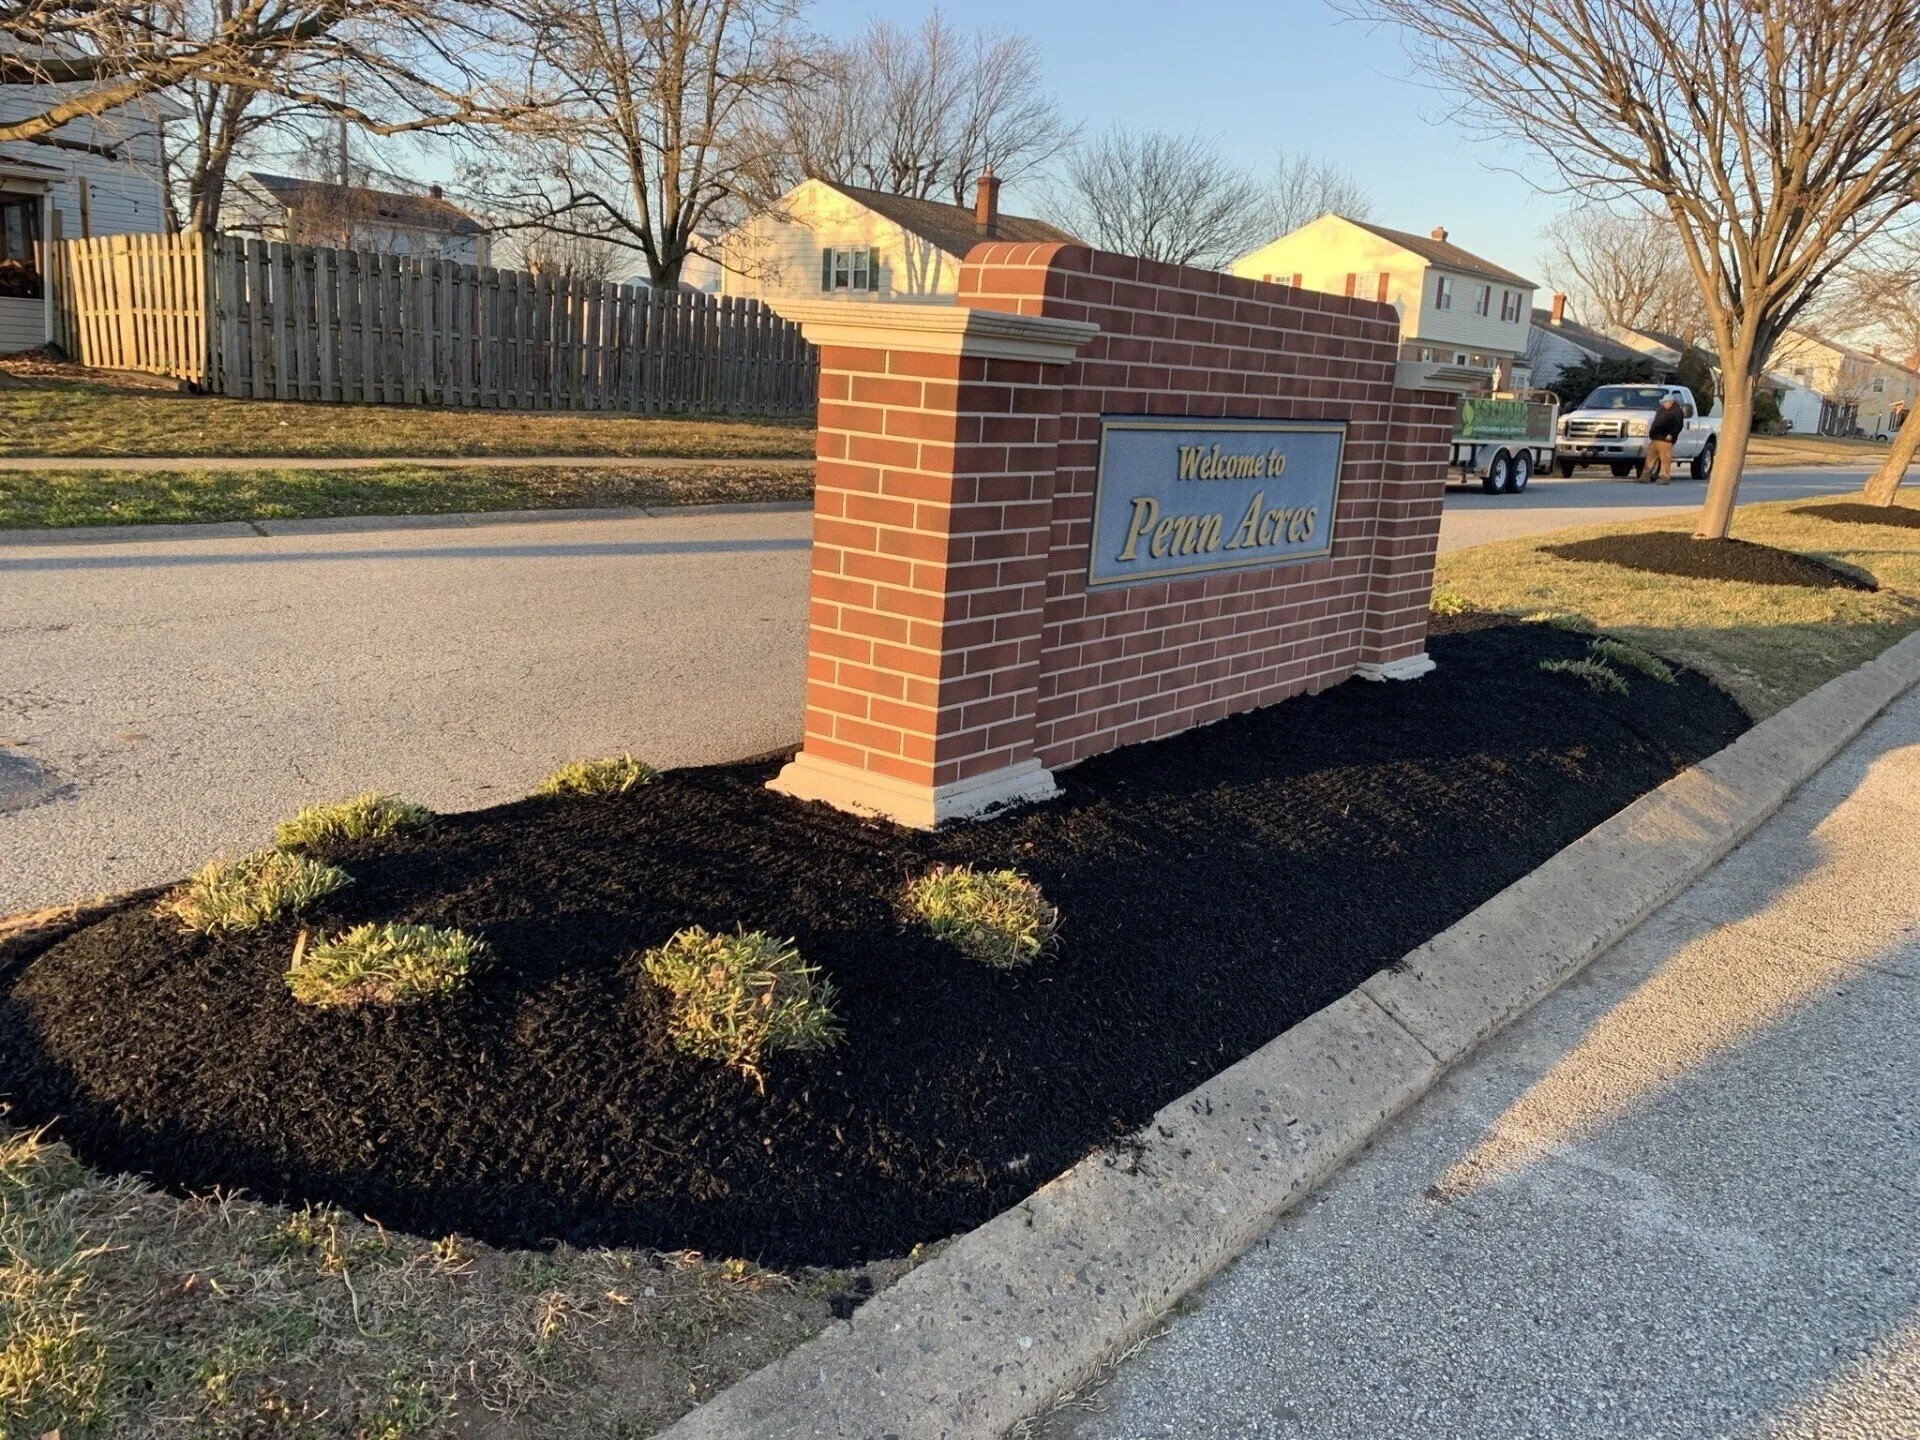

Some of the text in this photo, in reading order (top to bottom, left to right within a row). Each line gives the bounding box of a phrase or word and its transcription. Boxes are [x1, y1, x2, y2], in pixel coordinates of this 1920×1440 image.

[1177, 443, 1286, 480] Welcome to
[1117, 490, 1318, 561] Penn Acres
